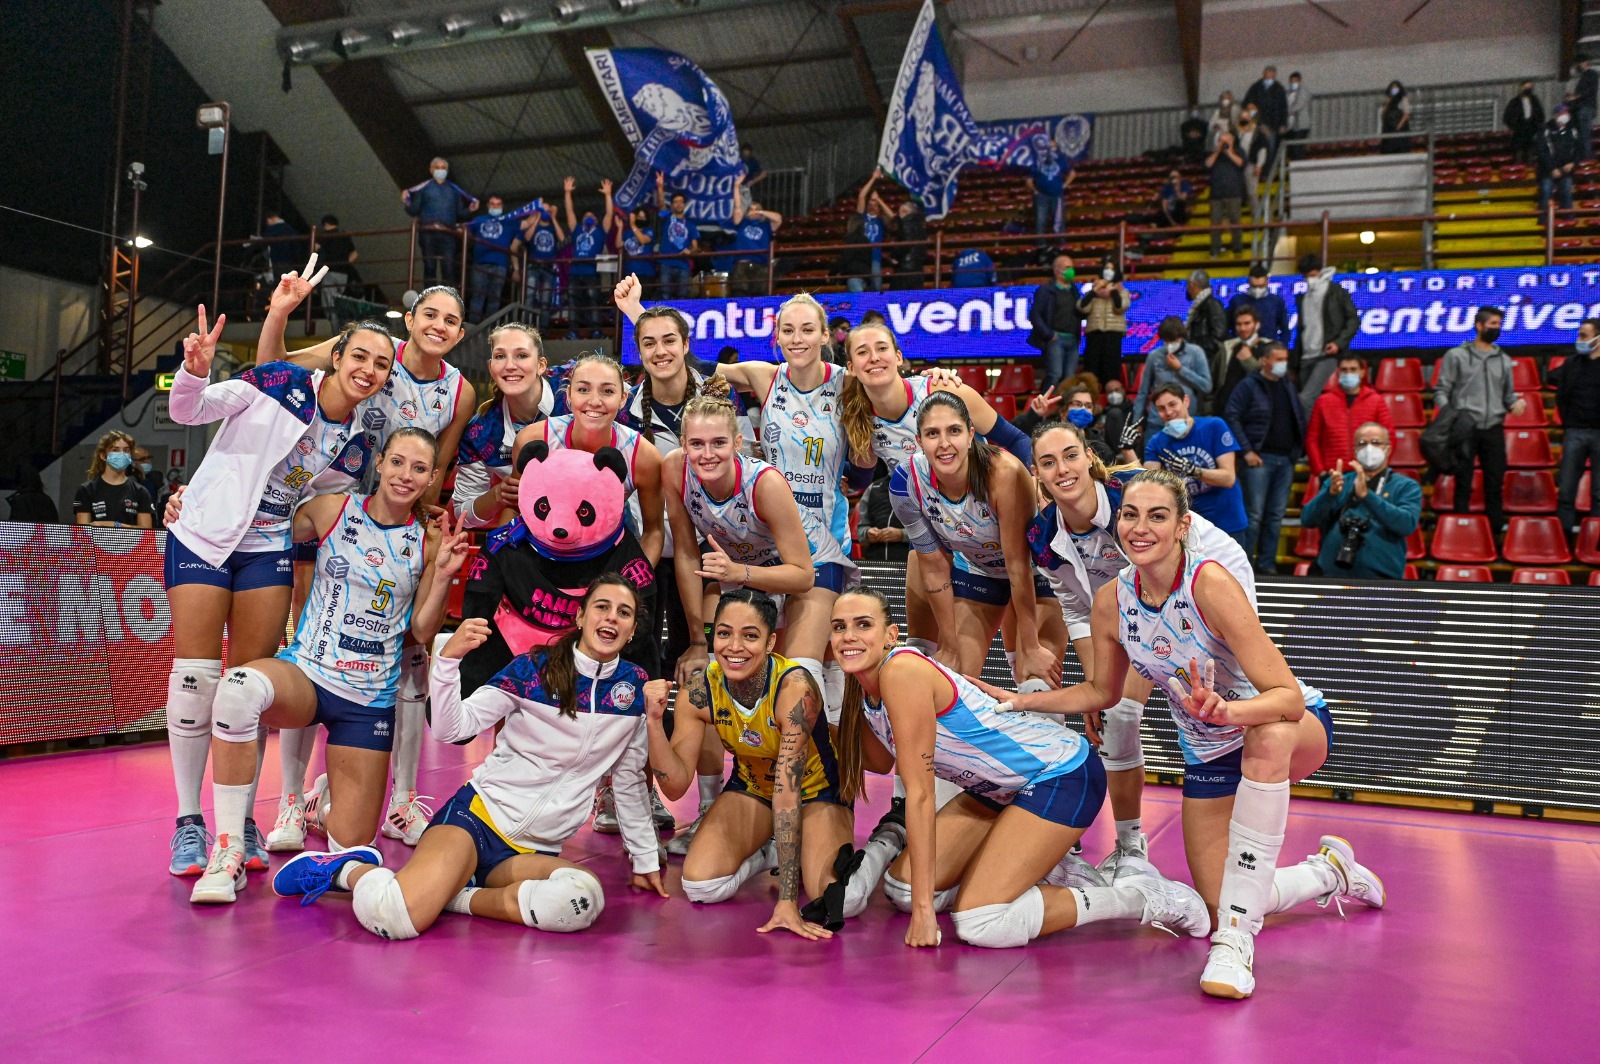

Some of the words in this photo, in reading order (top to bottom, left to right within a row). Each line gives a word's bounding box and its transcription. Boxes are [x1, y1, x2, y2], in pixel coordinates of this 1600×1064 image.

[434, 386, 448, 396] AON
[821, 389, 836, 397] AON
[803, 437, 824, 466] 11
[795, 473, 825, 485] estra
[347, 515, 364, 526] AON
[341, 534, 357, 545] errea
[401, 532, 418, 543] AON
[327, 582, 343, 618] SAVINO
[371, 578, 397, 613] 5
[1174, 599, 1189, 610] AON
[355, 616, 391, 635] estra
[336, 660, 375, 673] camst
[1237, 860, 1256, 871] errea
